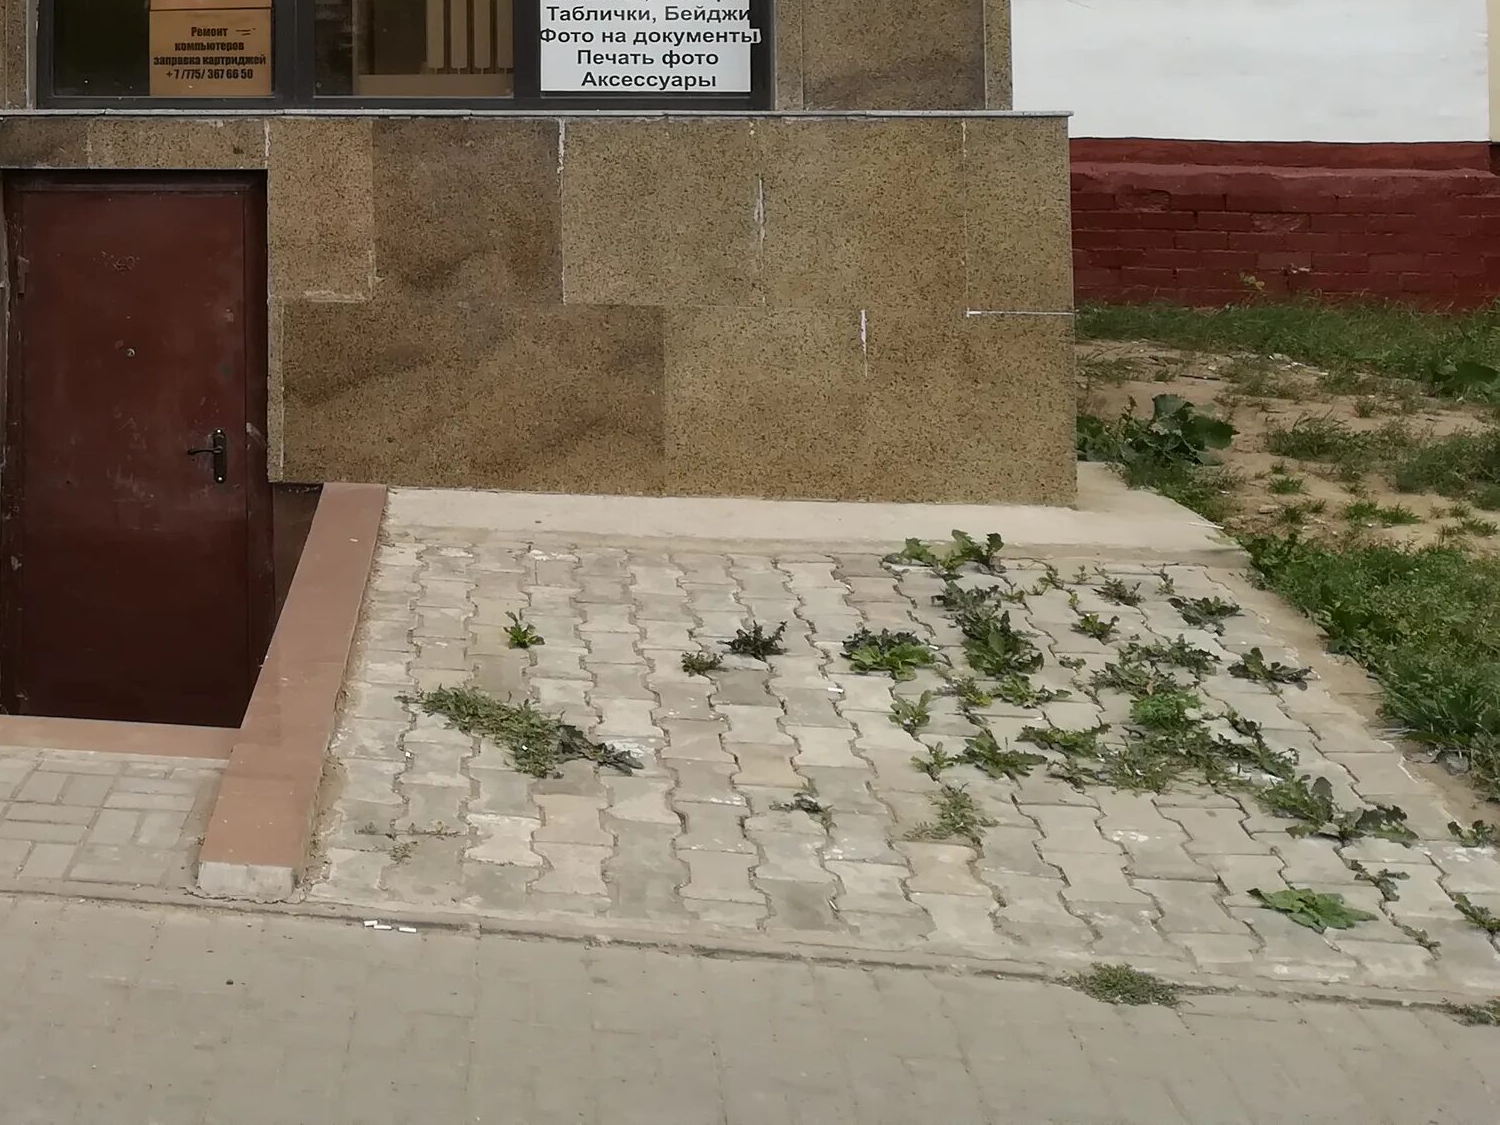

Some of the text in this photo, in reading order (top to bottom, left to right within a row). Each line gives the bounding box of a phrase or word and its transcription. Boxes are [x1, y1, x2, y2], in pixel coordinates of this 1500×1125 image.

[546, 5, 751, 24] Таблички, Бейджи
[191, 26, 229, 37] Ремонт
[540, 27, 758, 46] Фото на документы
[174, 41, 245, 52] компьютеров
[577, 50, 719, 68] Печать фото
[581, 71, 717, 90] Аксессуары
